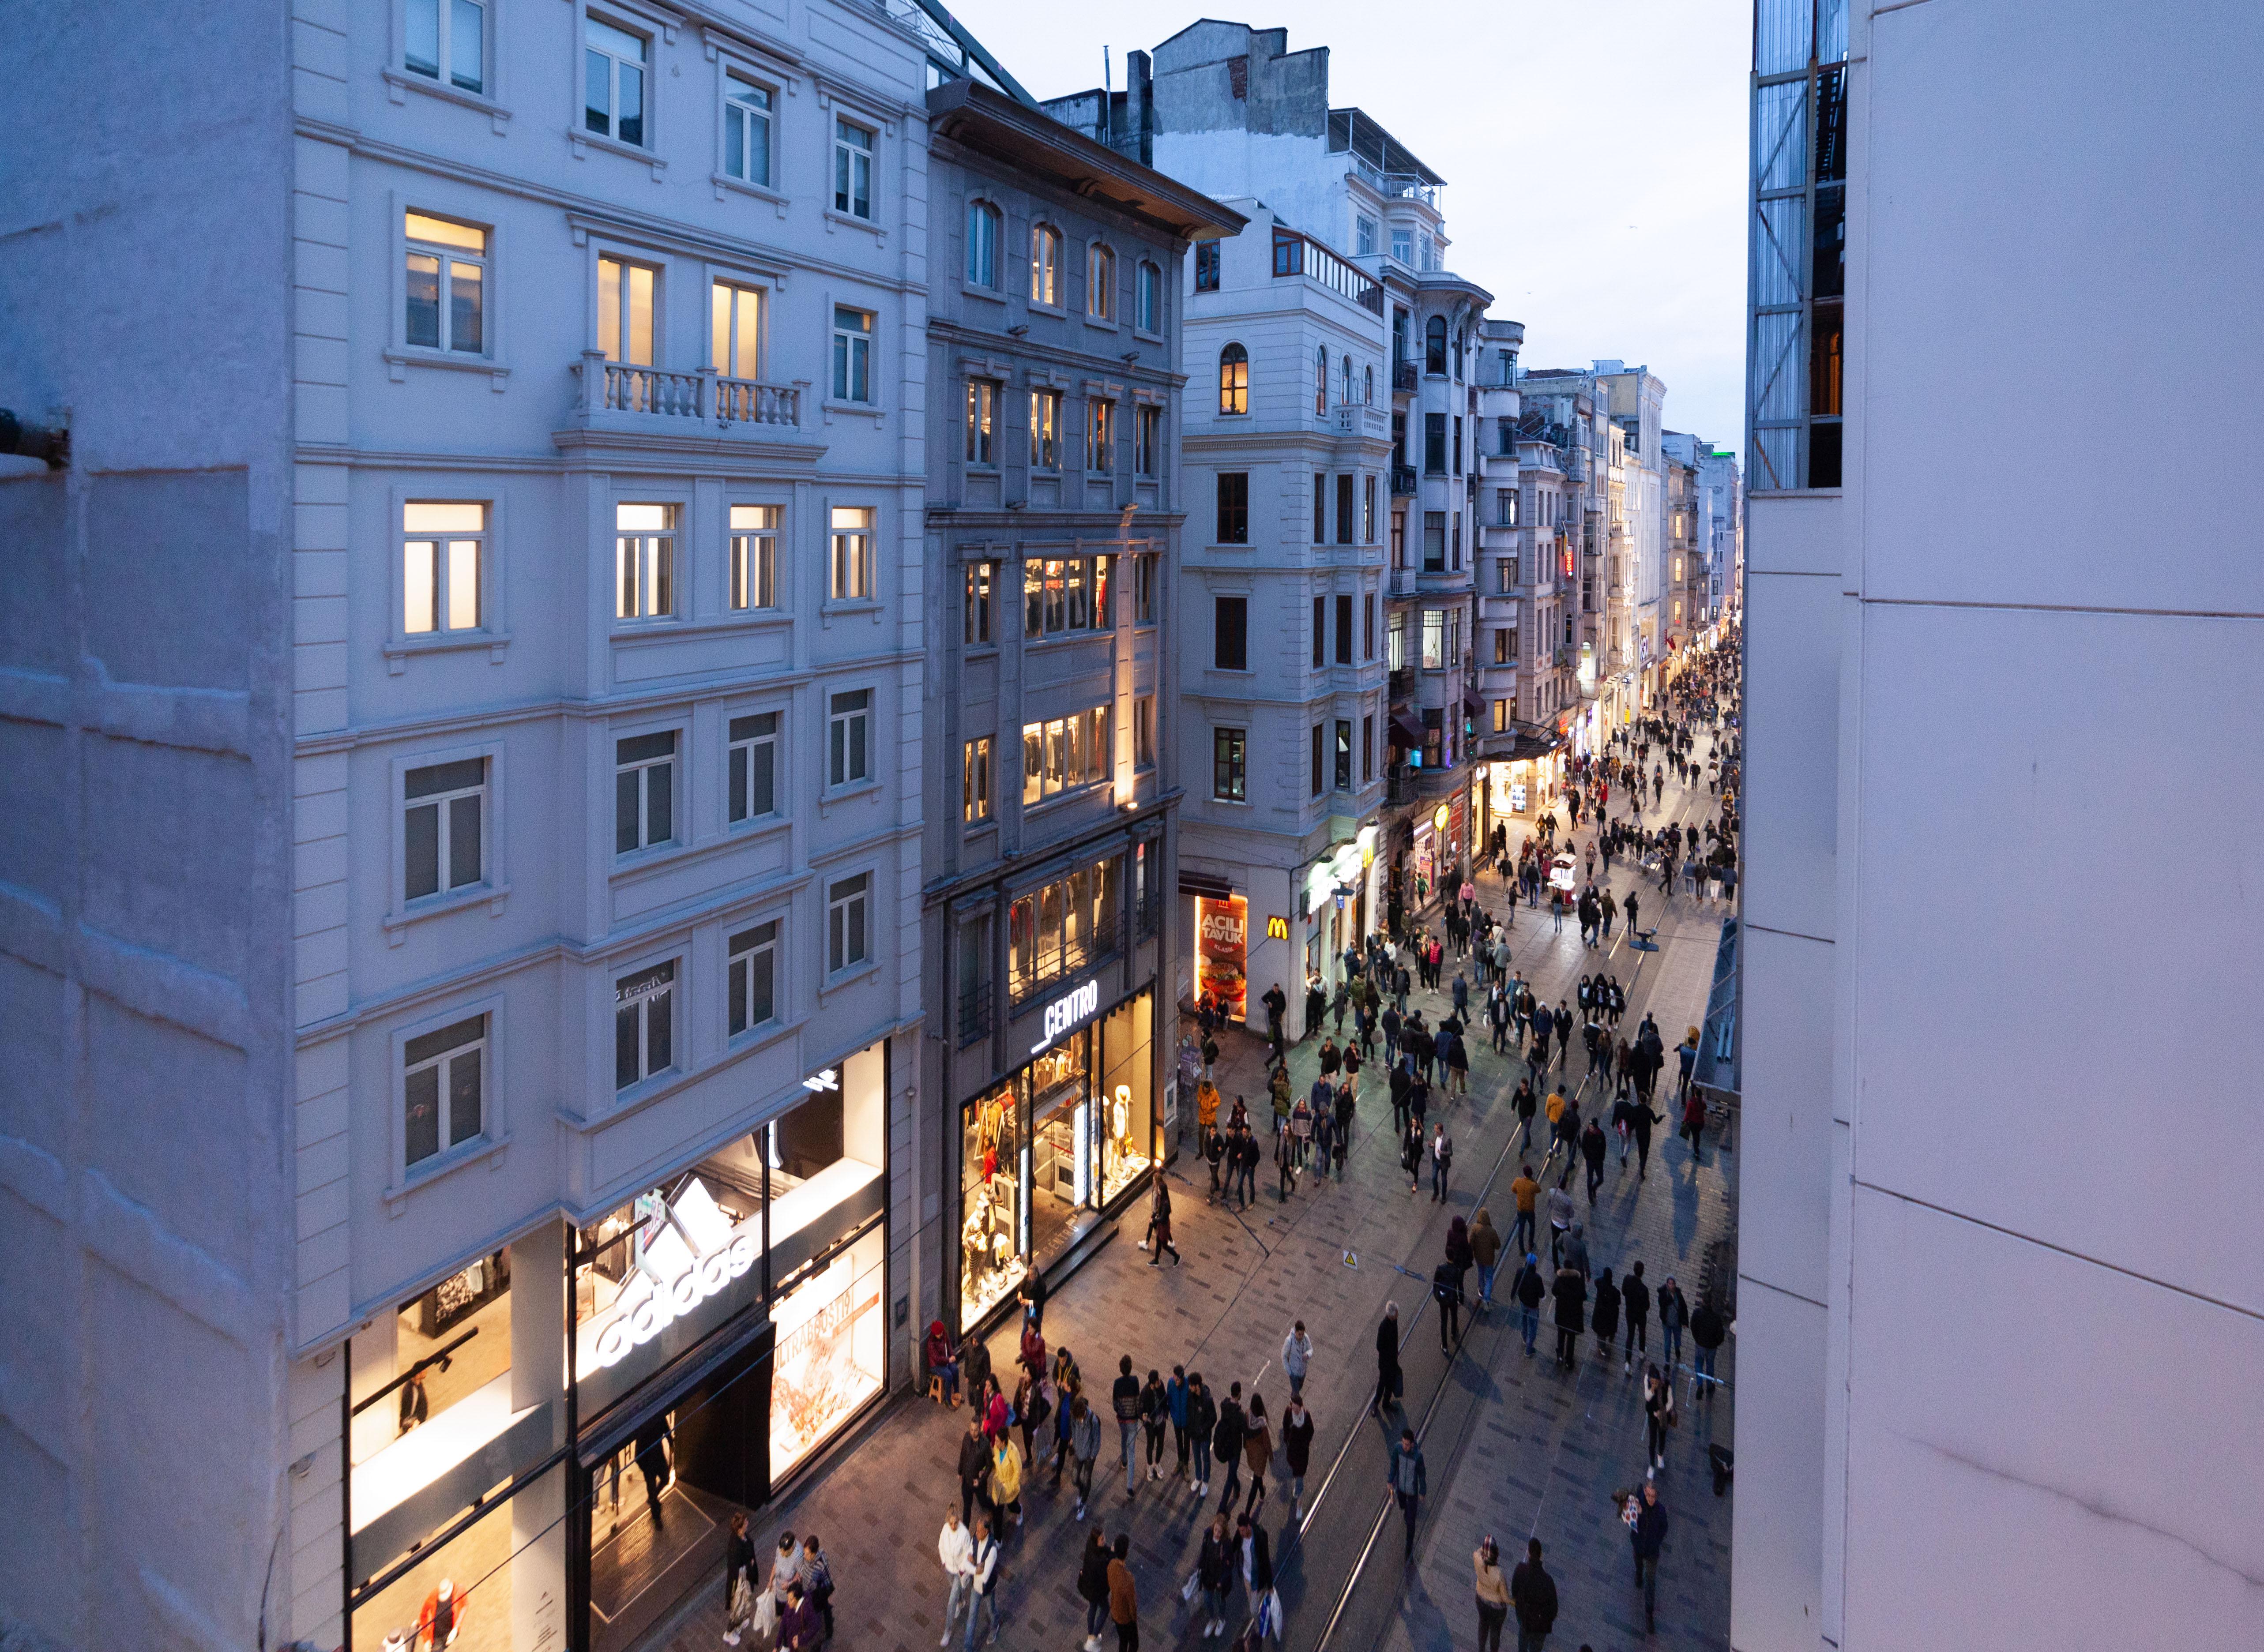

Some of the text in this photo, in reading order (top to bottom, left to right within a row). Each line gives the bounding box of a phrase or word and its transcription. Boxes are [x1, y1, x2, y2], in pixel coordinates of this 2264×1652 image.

[1201, 914, 1244, 934] ACILI
[1201, 927, 1243, 944] TAVUK
[1045, 980, 1097, 1039] CENTRO
[597, 1235, 754, 1367] adidas
